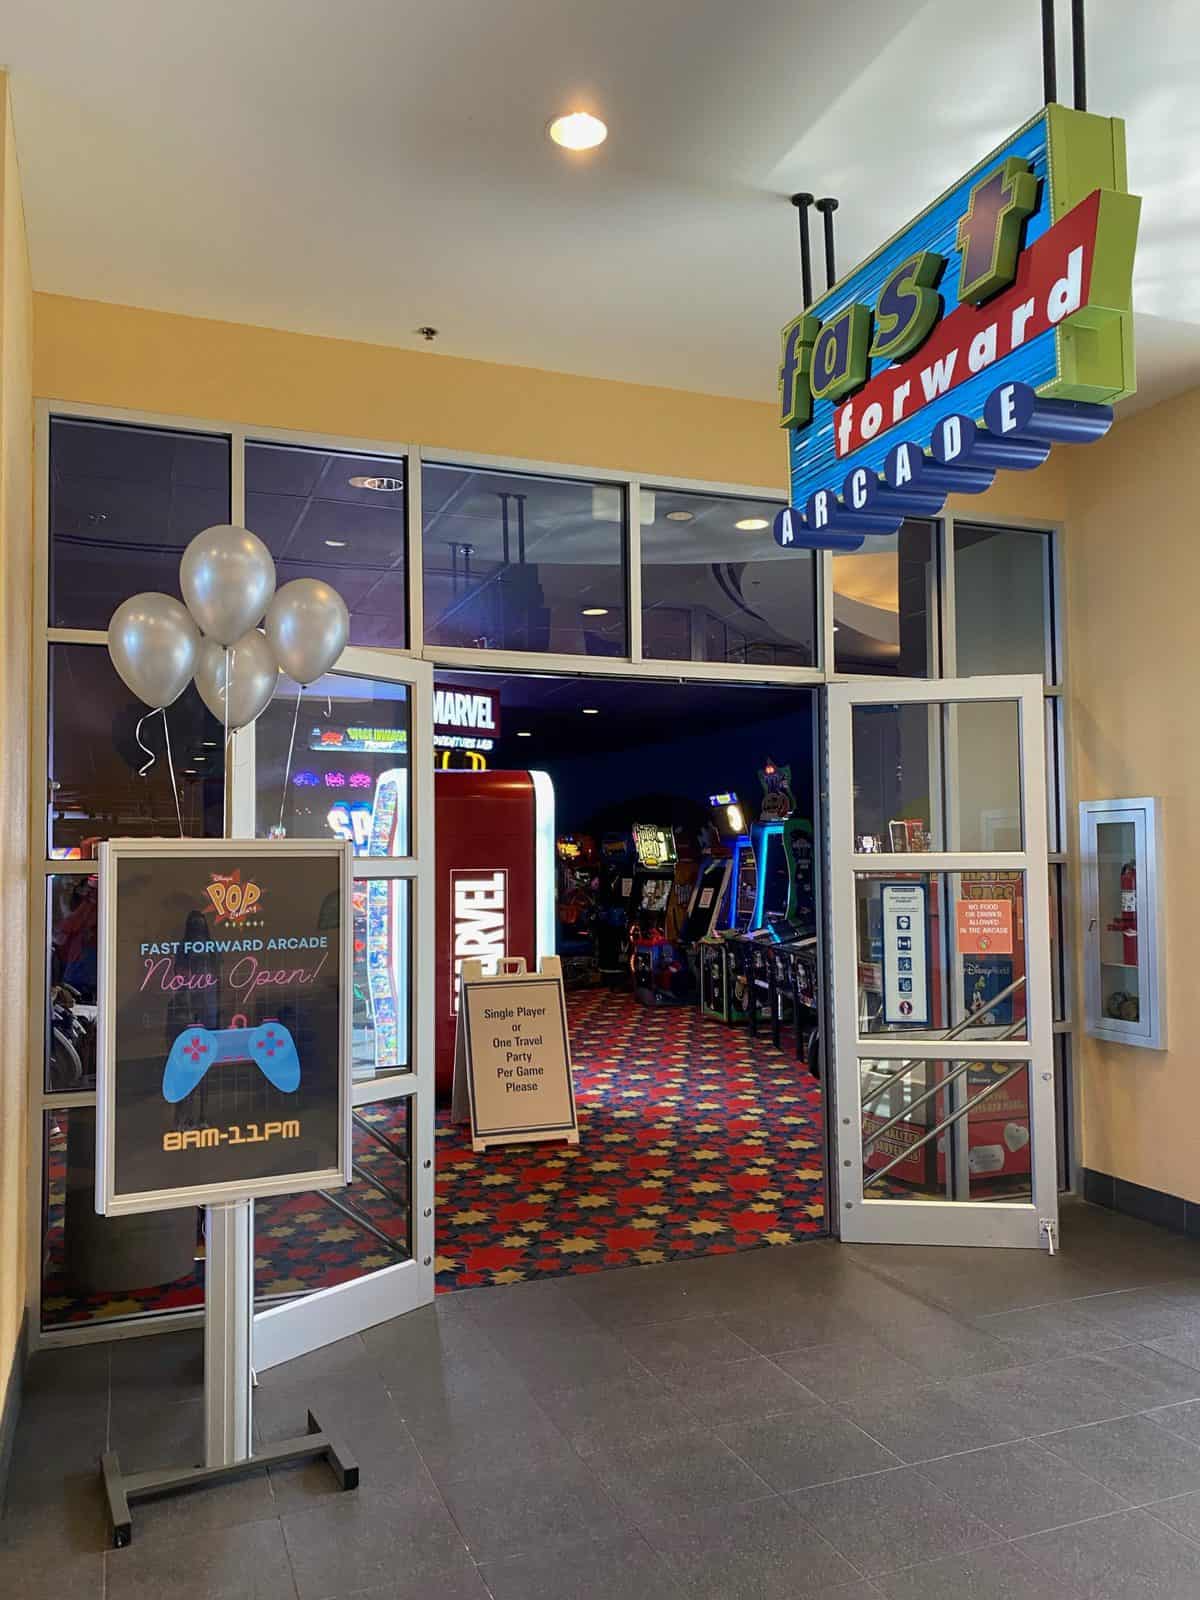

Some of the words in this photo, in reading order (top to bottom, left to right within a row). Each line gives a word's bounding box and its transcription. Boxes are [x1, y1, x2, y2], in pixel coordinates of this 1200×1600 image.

[779, 157, 1037, 428] fast
[838, 246, 1084, 457] forward
[781, 384, 1017, 546] ARCADE
[433, 735, 476, 749] DVENTURE
[206, 882, 261, 916] POP
[140, 942, 180, 956] FAST
[184, 938, 263, 954] FORWARD
[267, 936, 328, 951] ARCADE
[139, 957, 217, 992] Now
[229, 951, 329, 1004] Open!
[484, 1007, 514, 1020] Single
[517, 1006, 546, 1018] Player
[512, 1024, 522, 1032] or
[493, 1037, 512, 1049] One
[515, 1035, 543, 1047] Travel
[506, 1052, 532, 1063] Party
[497, 1067, 513, 1078] Per
[516, 1066, 544, 1077] Game
[506, 1082, 538, 1093] Please
[162, 1119, 300, 1151] 8AM-11PM
